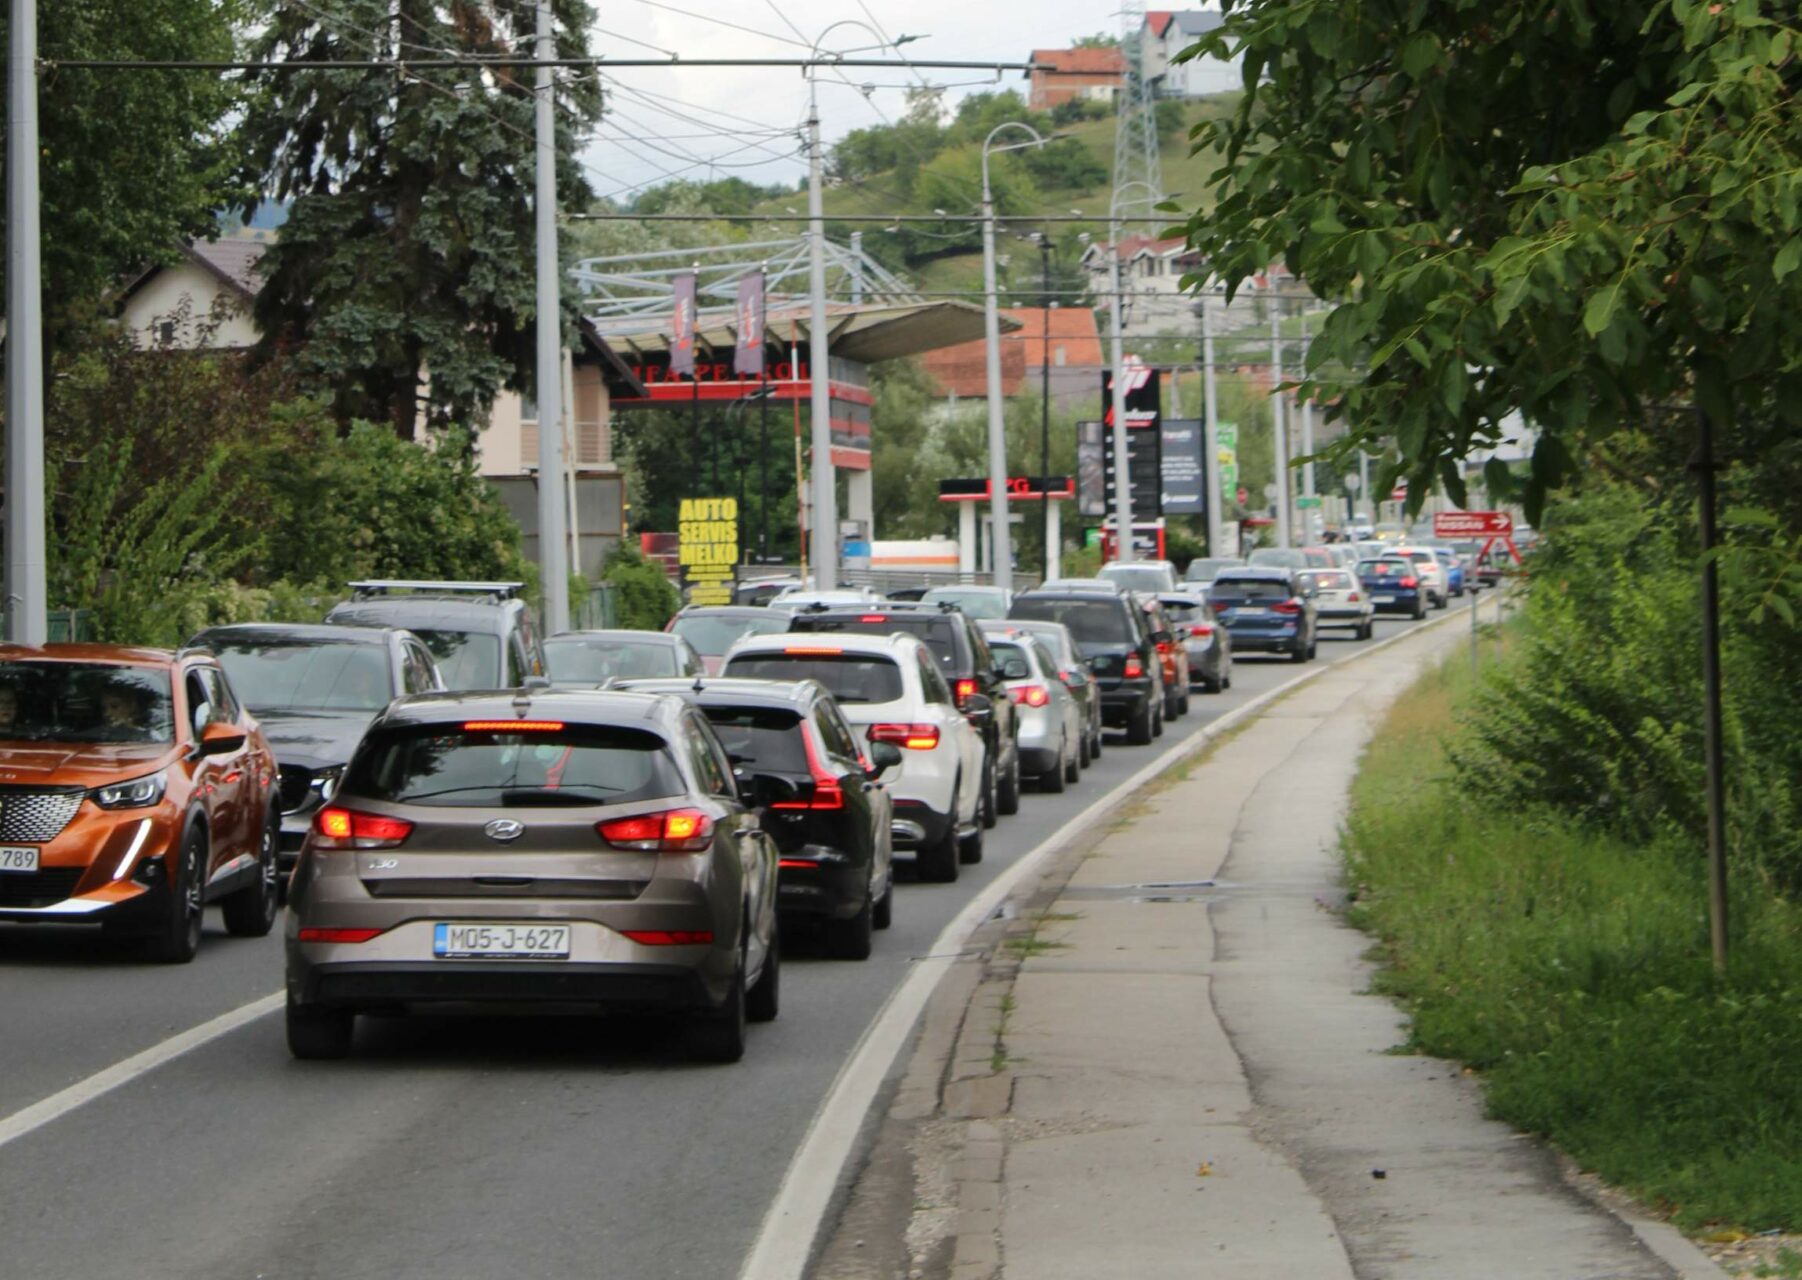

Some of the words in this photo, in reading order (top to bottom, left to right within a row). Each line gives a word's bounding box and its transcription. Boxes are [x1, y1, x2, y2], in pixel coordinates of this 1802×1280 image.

[680, 498, 738, 521] AUTO
[680, 521, 738, 543] SERVIS
[680, 543, 739, 565] MELKO
